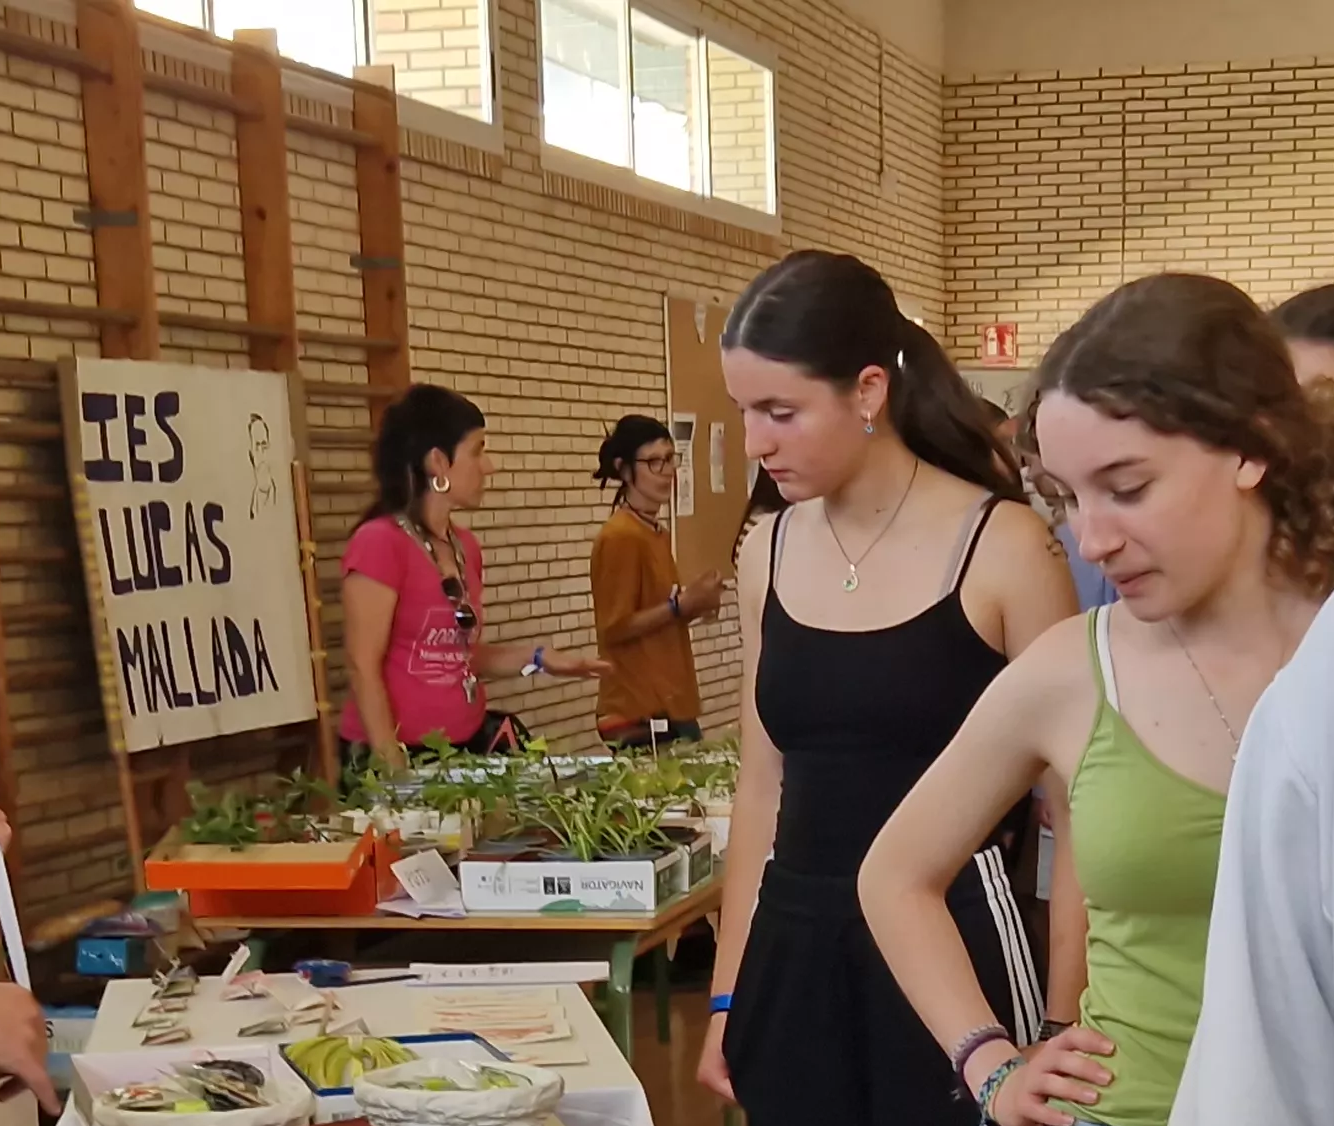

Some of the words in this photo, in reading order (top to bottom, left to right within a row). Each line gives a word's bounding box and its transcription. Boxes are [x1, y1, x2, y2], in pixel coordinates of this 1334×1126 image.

[81, 391, 185, 483] IES
[98, 500, 232, 596] LUCAS
[116, 616, 279, 717] MALLADA
[580, 878, 644, 892] NAVIGATOR
